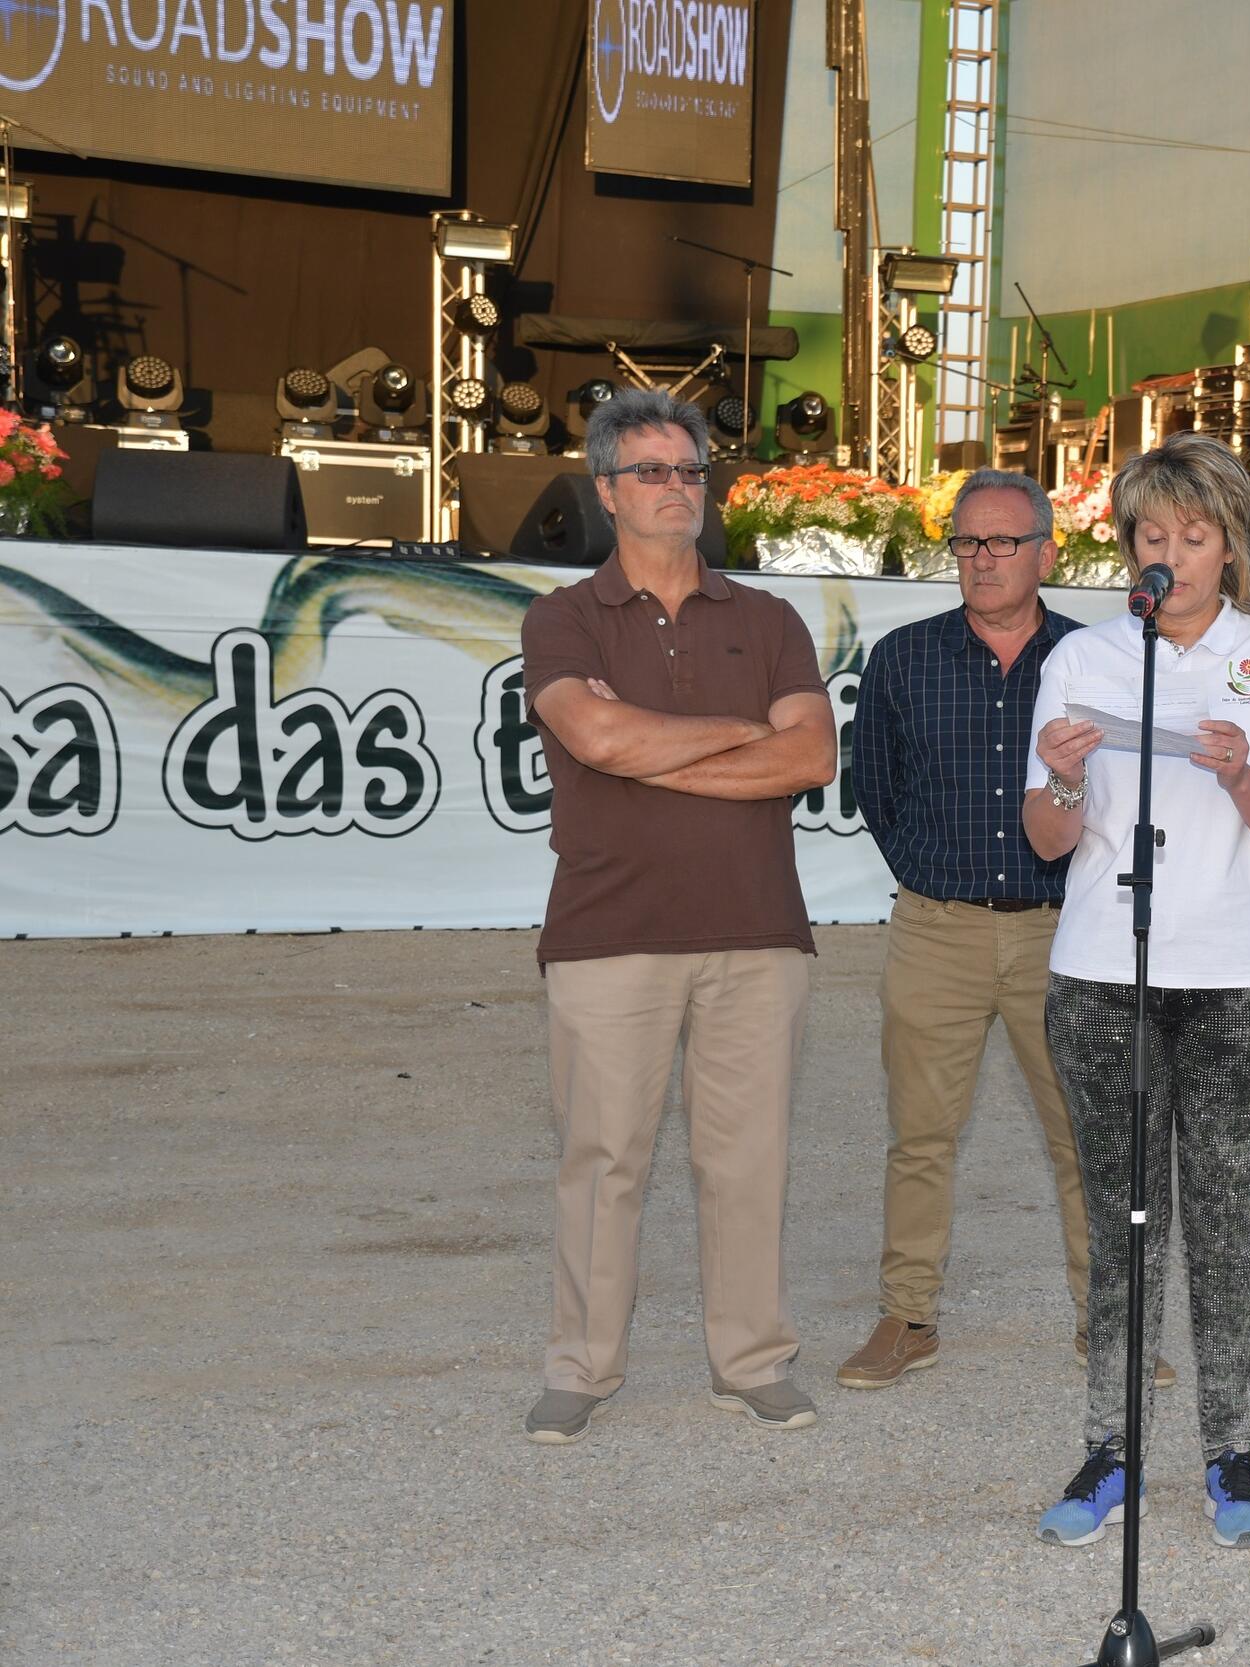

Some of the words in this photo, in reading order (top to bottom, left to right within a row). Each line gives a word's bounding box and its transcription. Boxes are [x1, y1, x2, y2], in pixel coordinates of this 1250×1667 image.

[629, 0, 749, 87] ROADSHOW
[106, 64, 169, 91] SOUND
[178, 74, 215, 97] AND
[224, 81, 311, 108] LIGHTING
[320, 92, 422, 121] EQUIPMENT
[182, 642, 426, 823] das
